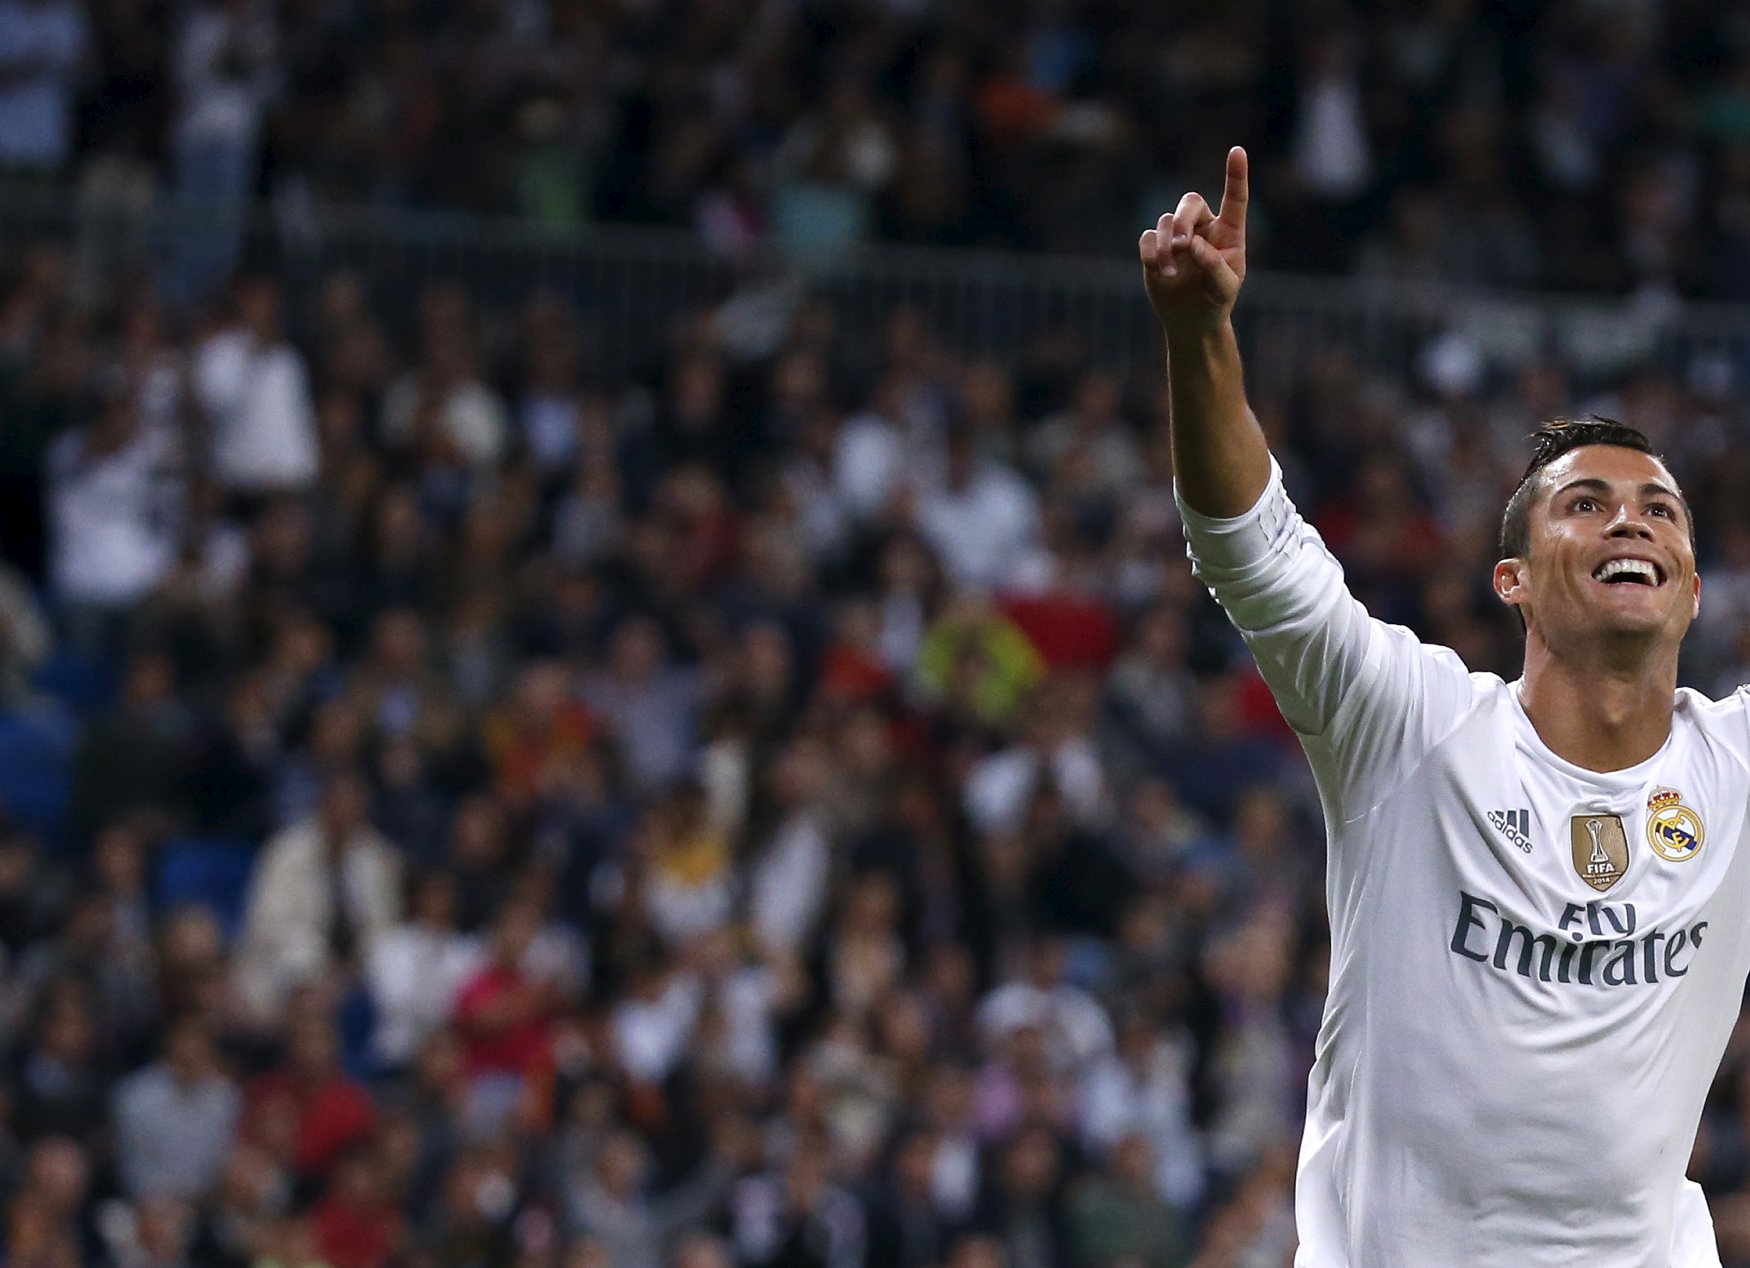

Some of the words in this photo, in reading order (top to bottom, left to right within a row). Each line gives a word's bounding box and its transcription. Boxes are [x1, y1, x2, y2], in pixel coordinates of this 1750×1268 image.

[1487, 810, 1533, 854] adidas
[1586, 863, 1615, 874] FIFA
[1558, 901, 1637, 938] Fly
